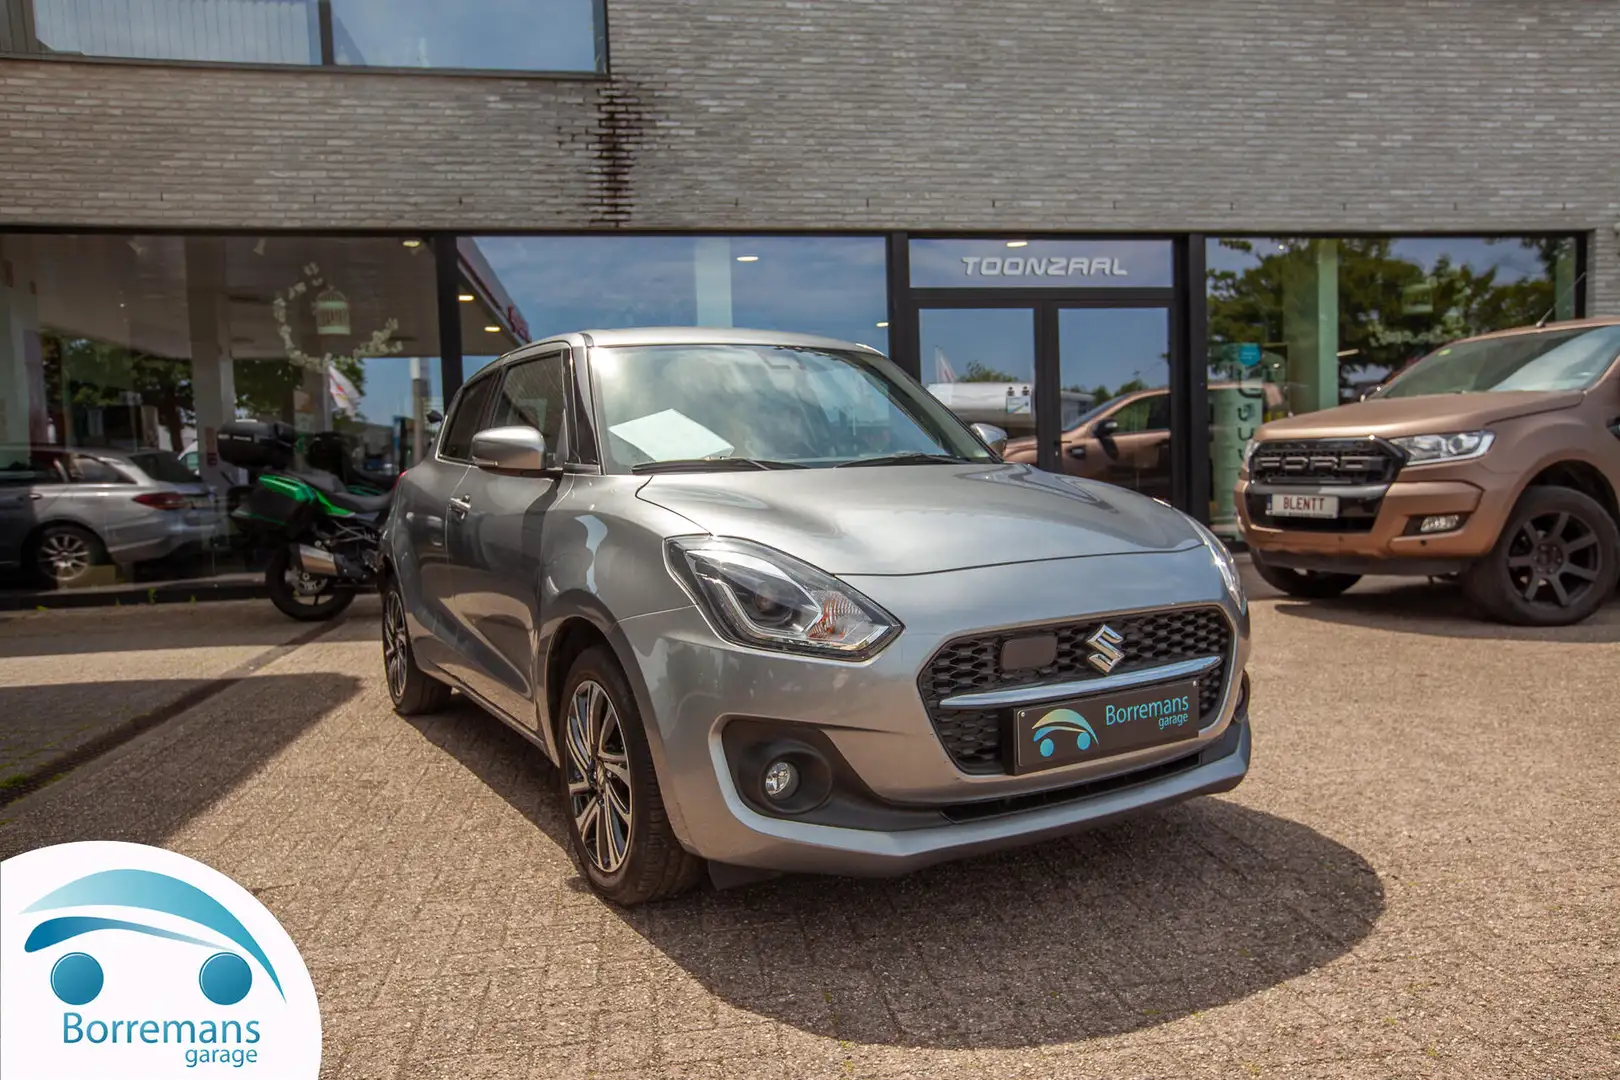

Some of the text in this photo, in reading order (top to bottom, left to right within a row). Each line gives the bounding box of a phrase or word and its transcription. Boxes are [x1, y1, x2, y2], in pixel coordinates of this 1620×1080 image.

[961, 256, 1129, 277] TOONZAAL
[1283, 496, 1326, 511] BLENTT
[1105, 694, 1190, 727] Borremans
[1158, 712, 1189, 731] garage
